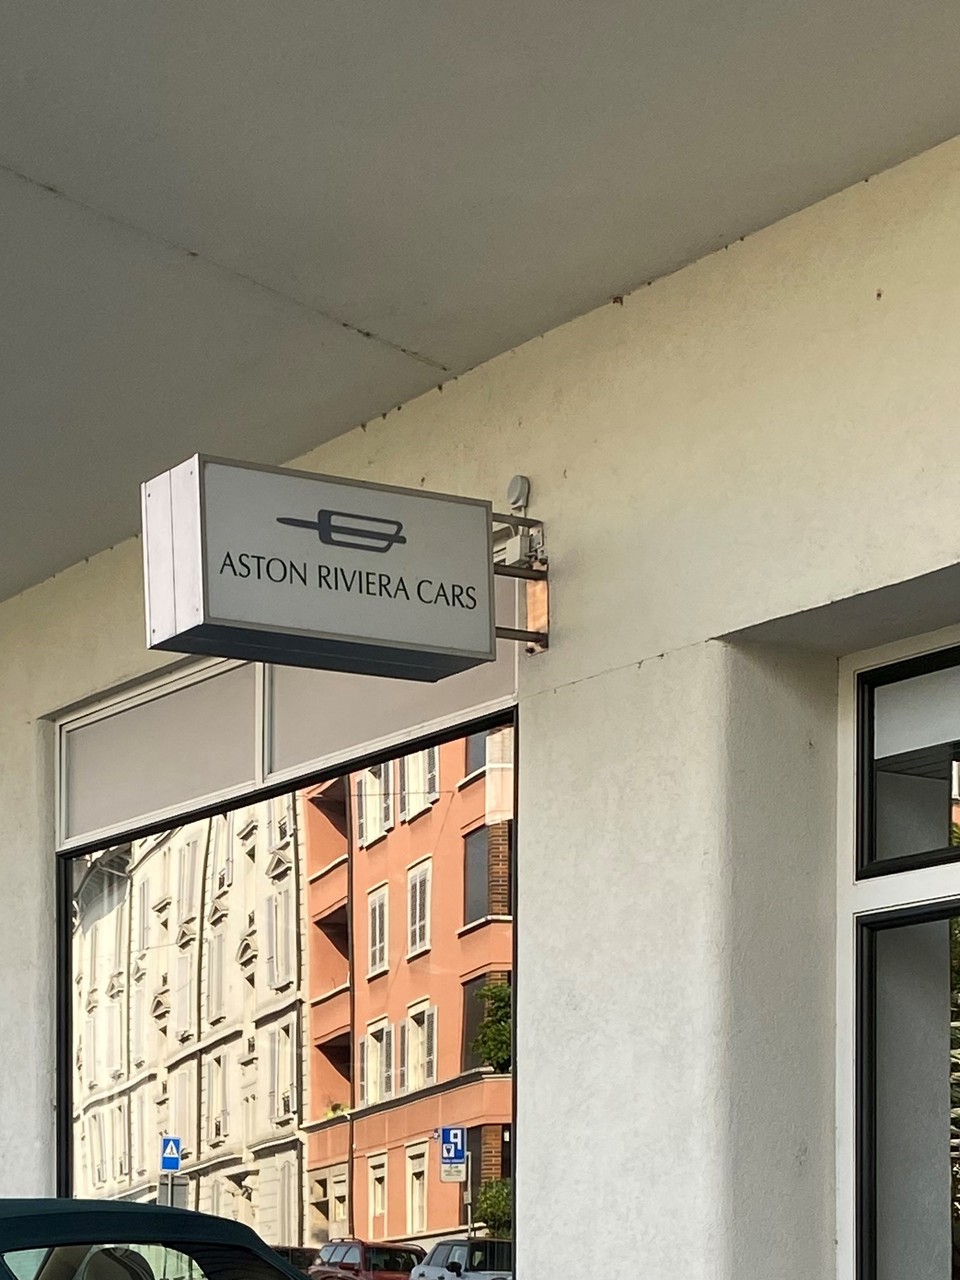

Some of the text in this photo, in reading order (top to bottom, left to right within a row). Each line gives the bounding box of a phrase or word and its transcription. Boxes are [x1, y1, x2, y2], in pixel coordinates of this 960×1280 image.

[220, 551, 477, 610] ASTON RIVIERA CARS
